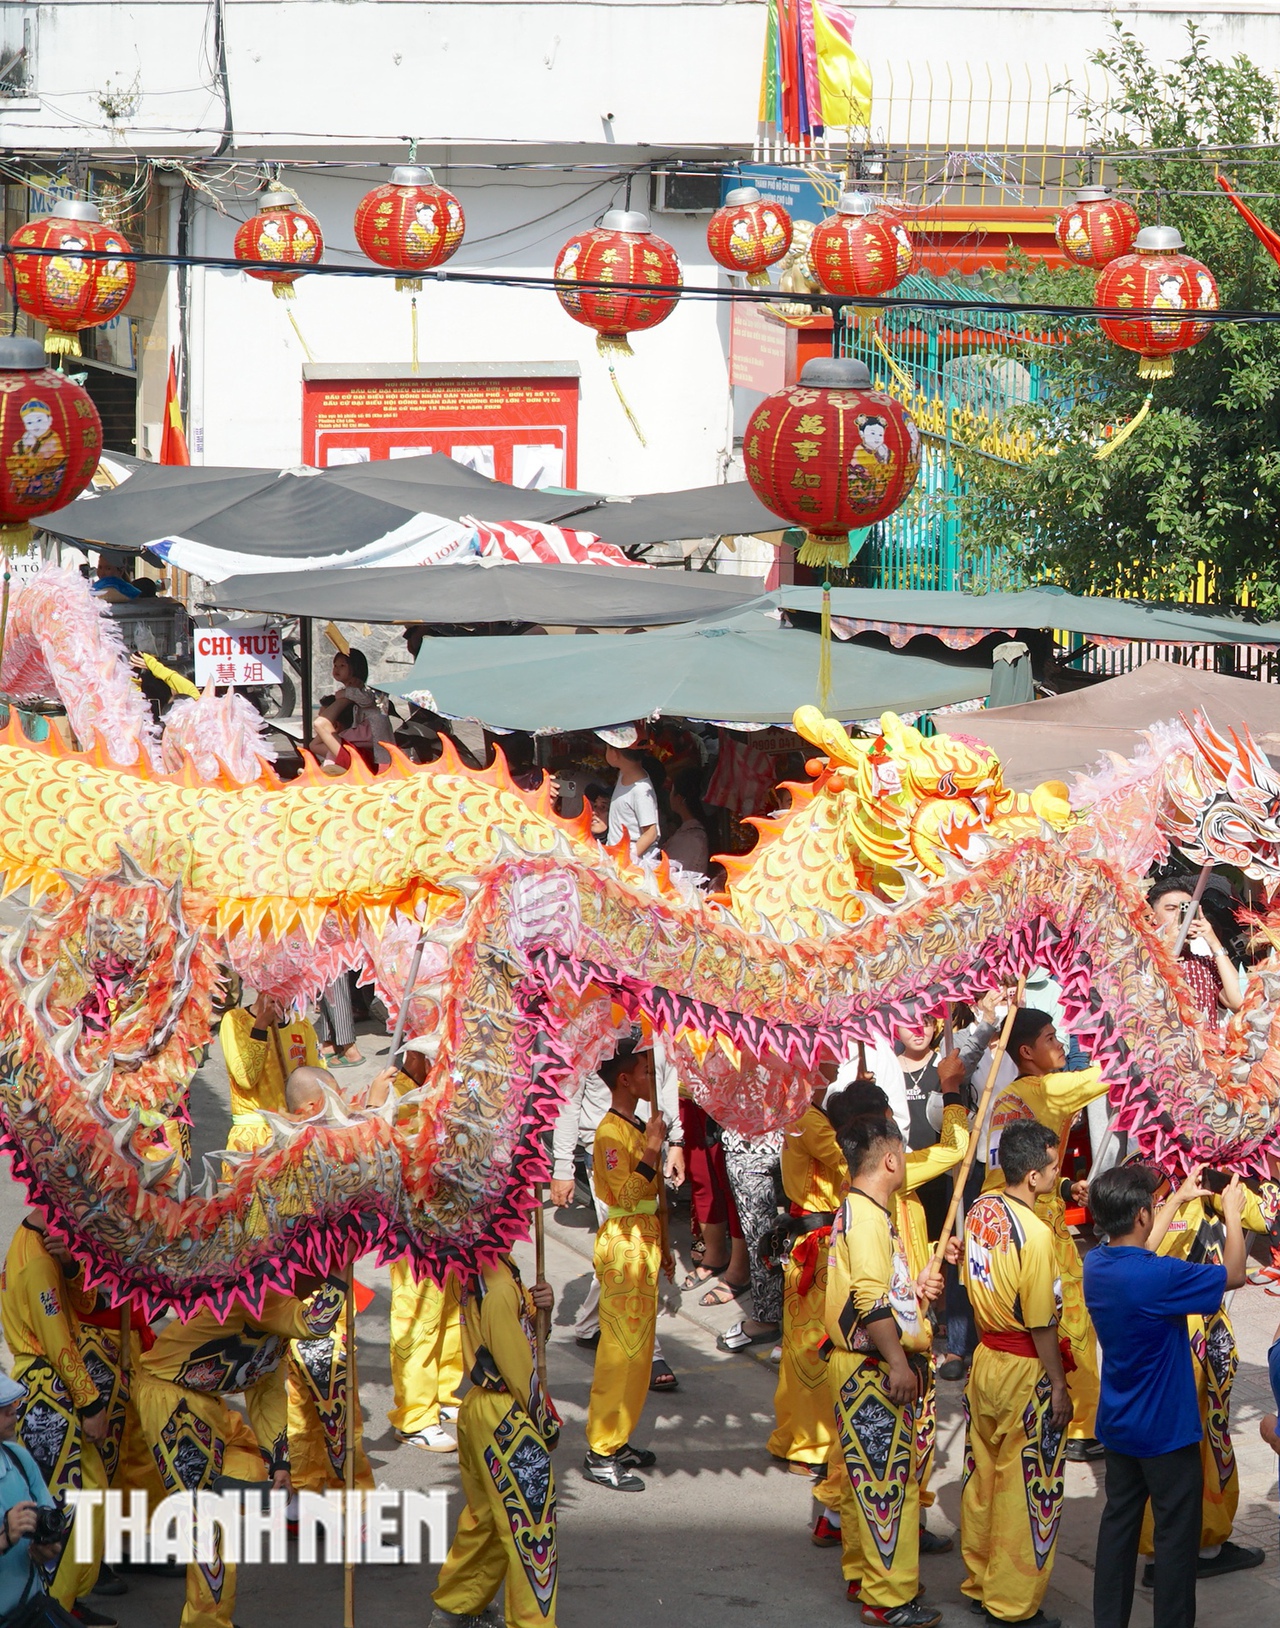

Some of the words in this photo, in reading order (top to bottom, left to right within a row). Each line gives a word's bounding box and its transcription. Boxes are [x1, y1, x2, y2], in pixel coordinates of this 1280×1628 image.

[789, 414, 827, 514] 萬事如意
[198, 637, 233, 661] CHỊ
[238, 630, 280, 660] HUỆ
[216, 662, 265, 683] 慧姐
